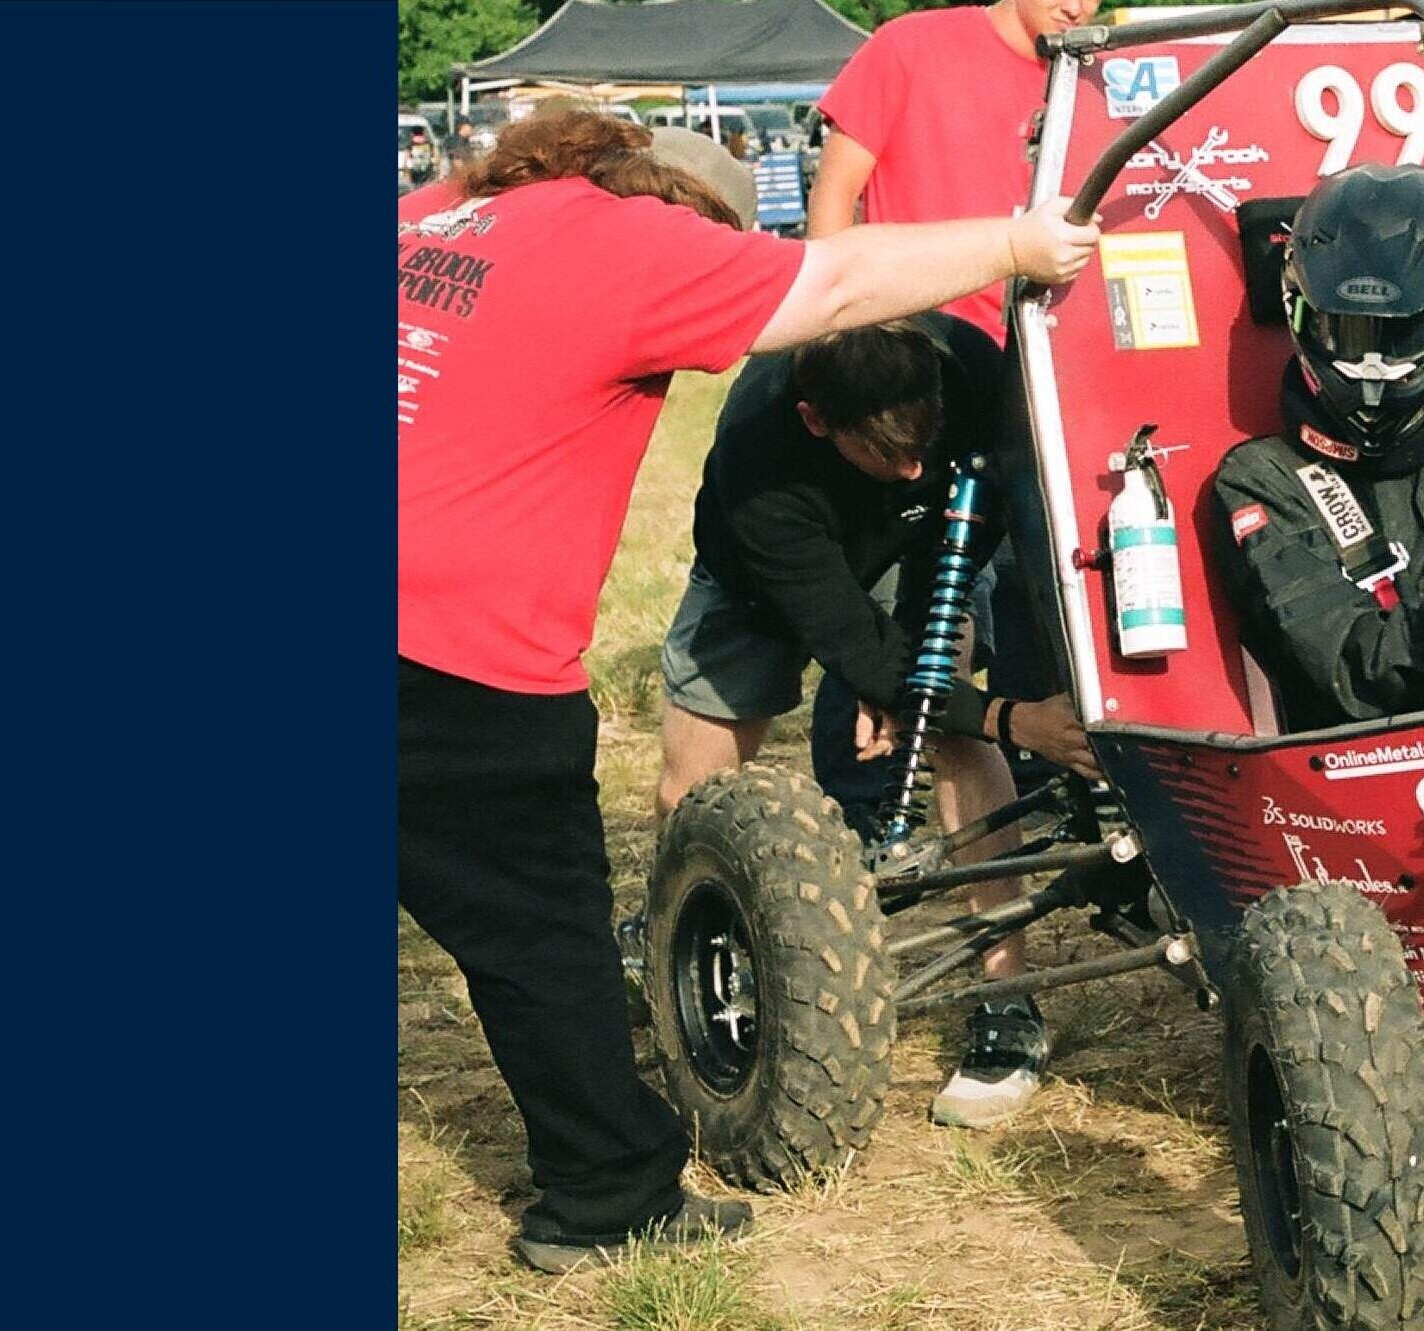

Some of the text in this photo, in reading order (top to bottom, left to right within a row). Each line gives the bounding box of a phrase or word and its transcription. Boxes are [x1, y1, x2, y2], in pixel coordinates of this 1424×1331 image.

[402, 247, 494, 288] BROOK
[1347, 283, 1391, 297] BELL
[1318, 486, 1360, 540] CROW
[1289, 813, 1388, 836] SOLIDWORKS
